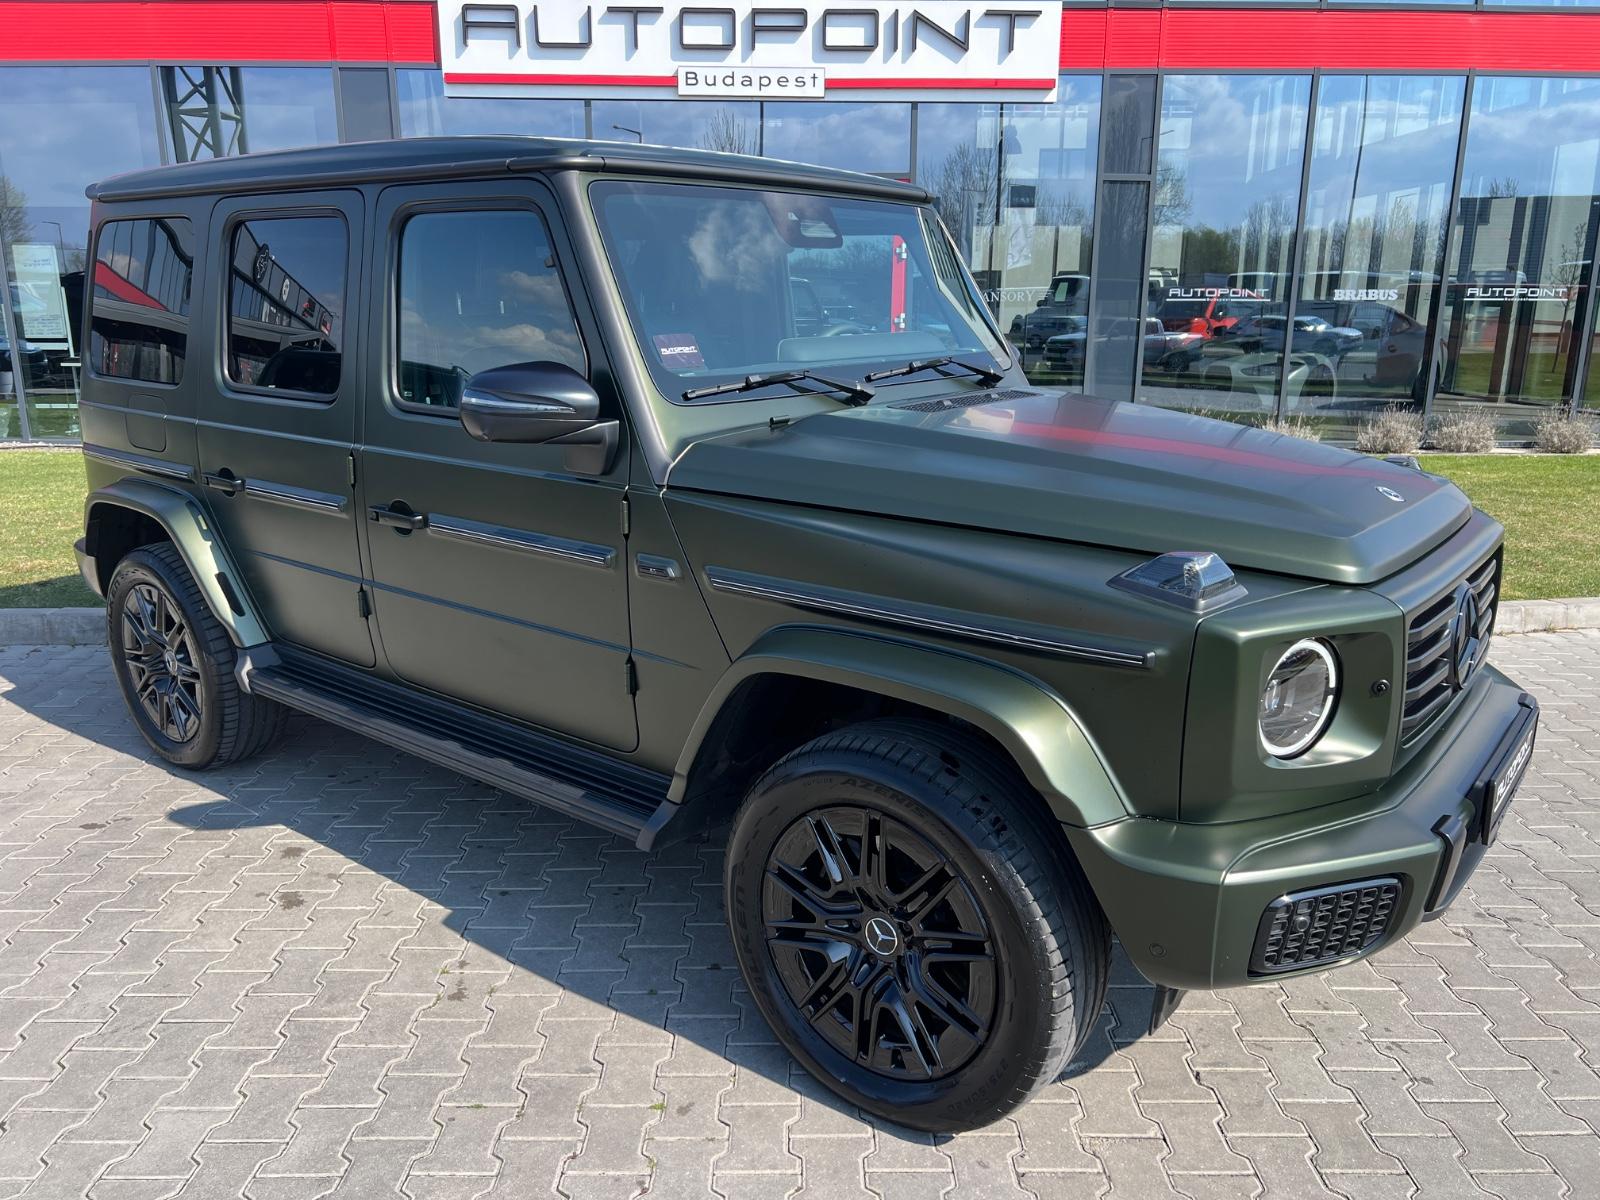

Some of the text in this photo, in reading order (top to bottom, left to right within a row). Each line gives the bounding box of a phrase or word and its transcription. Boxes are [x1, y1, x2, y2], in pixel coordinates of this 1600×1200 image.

[461, 4, 1043, 53] AUTOPOINT
[684, 71, 820, 91] Budapest
[982, 290, 1035, 302] ANSORY
[1169, 287, 1270, 298] AUTOPOINT
[1333, 288, 1399, 301] BRABUS
[1466, 287, 1568, 298] AUTOPOINT
